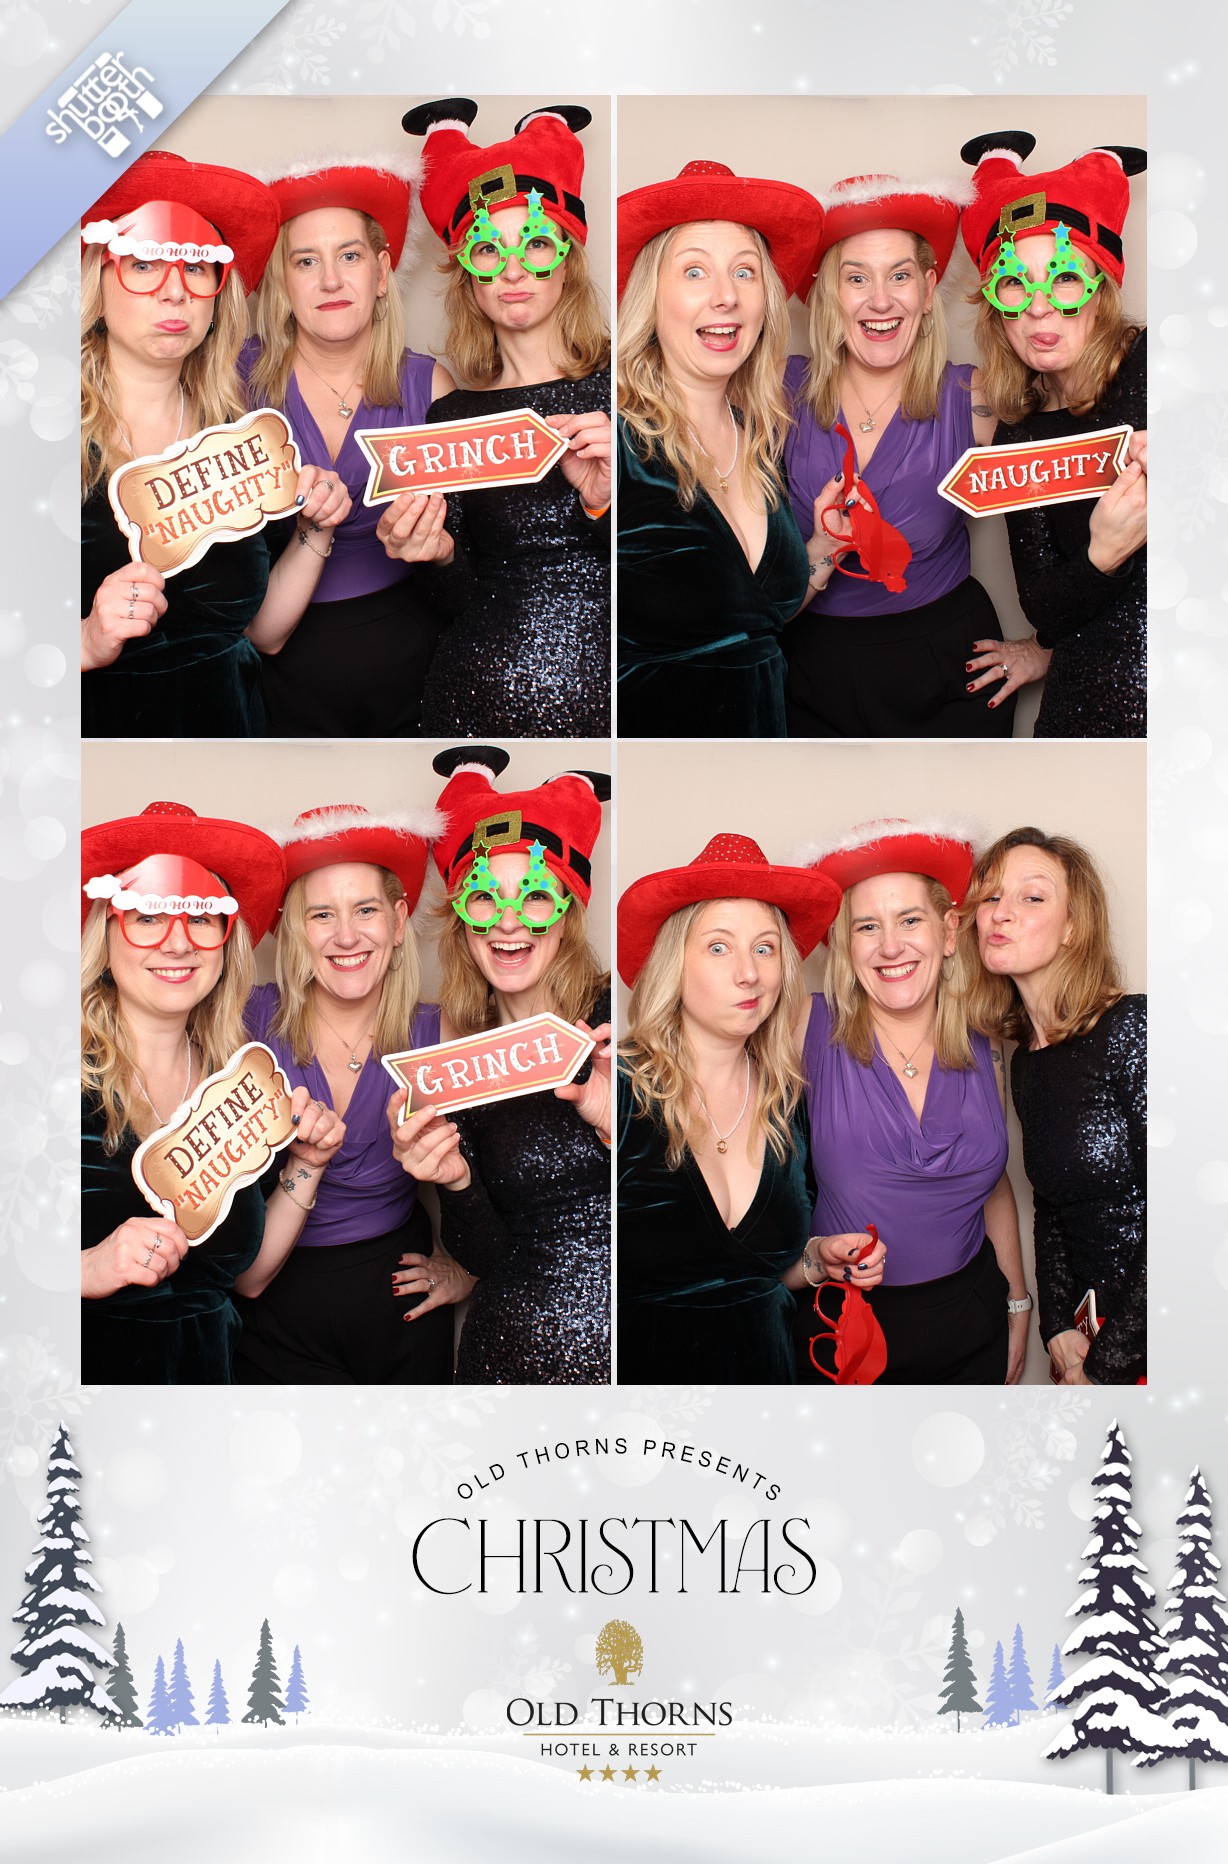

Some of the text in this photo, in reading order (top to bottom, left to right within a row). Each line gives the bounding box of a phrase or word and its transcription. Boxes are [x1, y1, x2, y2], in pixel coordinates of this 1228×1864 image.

[142, 246, 209, 258] HO HO HO
[144, 433, 270, 510] DEFINE
[388, 428, 539, 477] GRINCH
[968, 451, 1112, 494] NAUGHTY
[142, 460, 292, 546] "NAUGHTY"
[145, 900, 213, 910] HO HO HO
[415, 1032, 564, 1095] GRINCH
[163, 1071, 265, 1180] DEFINE
[173, 1088, 286, 1211] "NAUGHTY"
